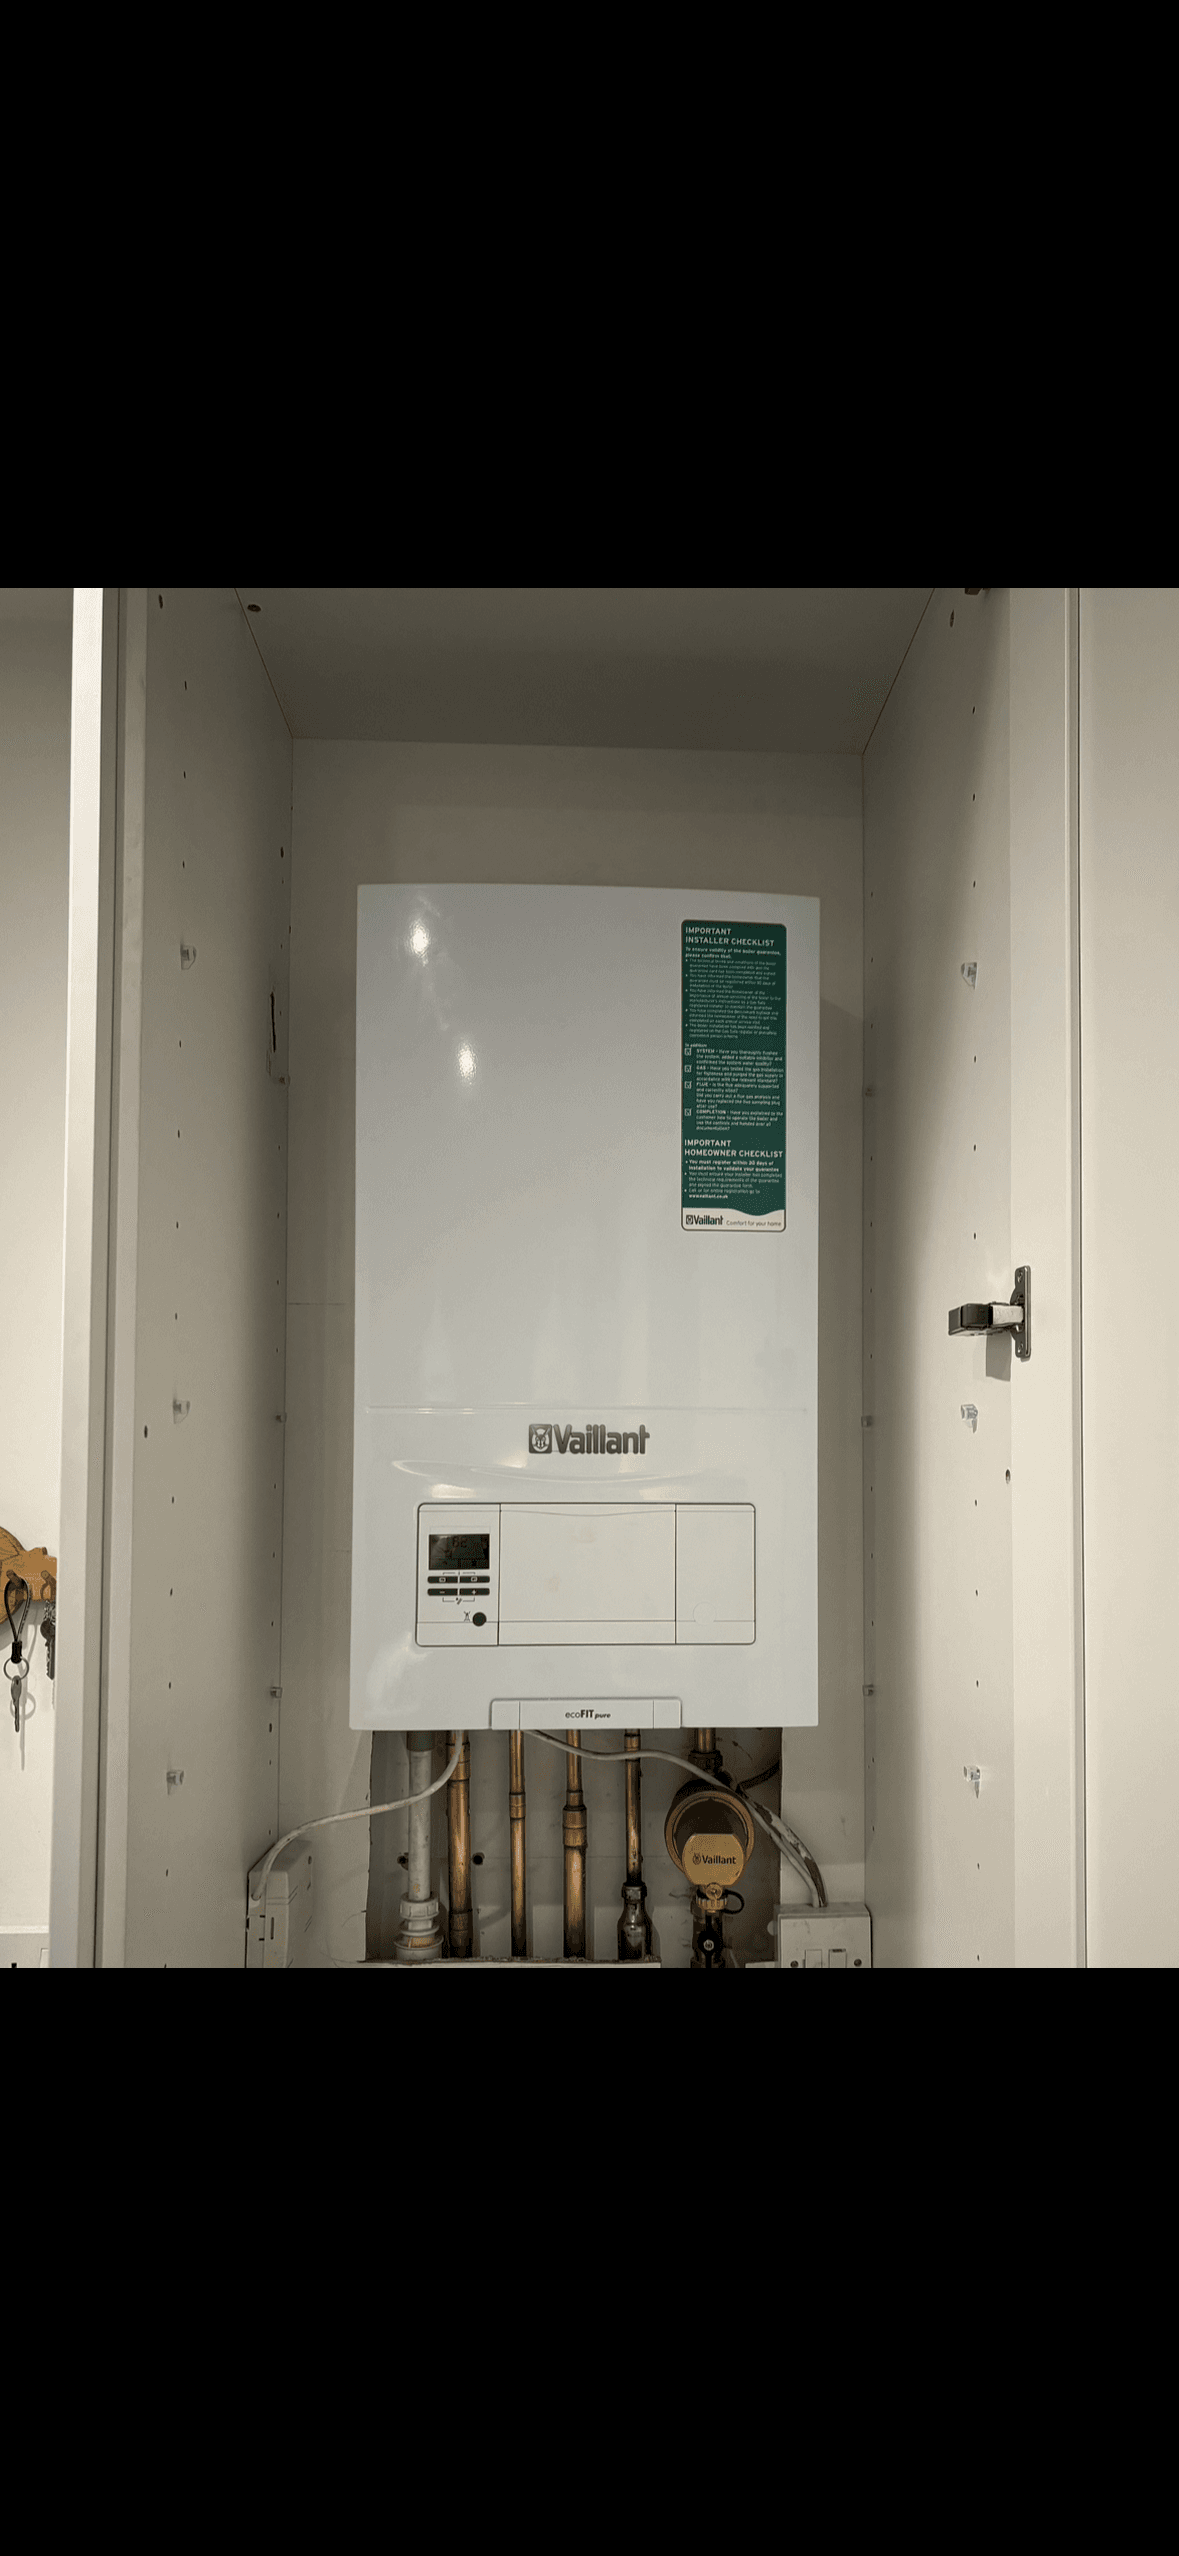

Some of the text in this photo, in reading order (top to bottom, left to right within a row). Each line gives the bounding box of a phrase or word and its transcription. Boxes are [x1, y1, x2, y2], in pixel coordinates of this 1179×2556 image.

[685, 926, 731, 935] IMPORTANT
[685, 936, 774, 947] INSTALLER CHECKLIST
[684, 1139, 731, 1147] IMPORTANT
[684, 1149, 783, 1158] HOMEOWNER CHECKLIST
[694, 1215, 724, 1225] Vaillant
[554, 1423, 650, 1455] Vaillant
[565, 1709, 594, 1718] ecoFIT
[702, 1855, 736, 1864] Vaillant
